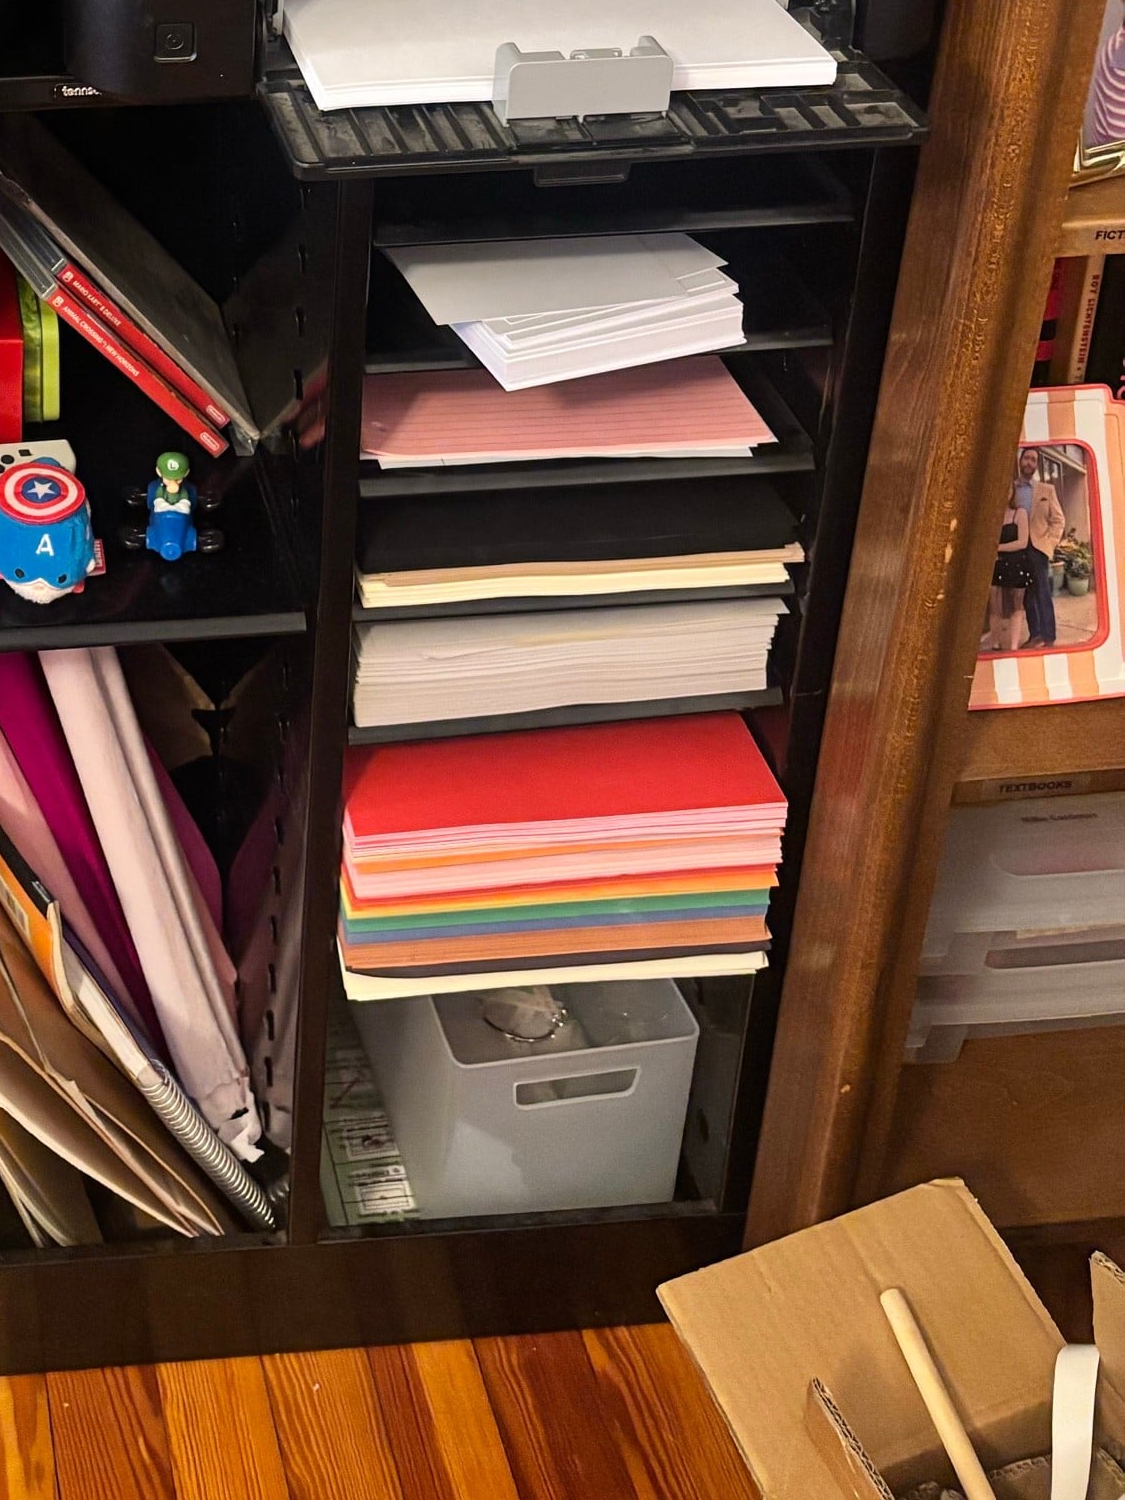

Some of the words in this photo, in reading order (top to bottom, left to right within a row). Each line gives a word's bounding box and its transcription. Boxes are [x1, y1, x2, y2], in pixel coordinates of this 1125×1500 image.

[71, 279, 89, 296] MARIO
[62, 304, 82, 324] ANIMAL
[36, 534, 54, 556] A
[999, 780, 1073, 793] TEXTBOOKS
